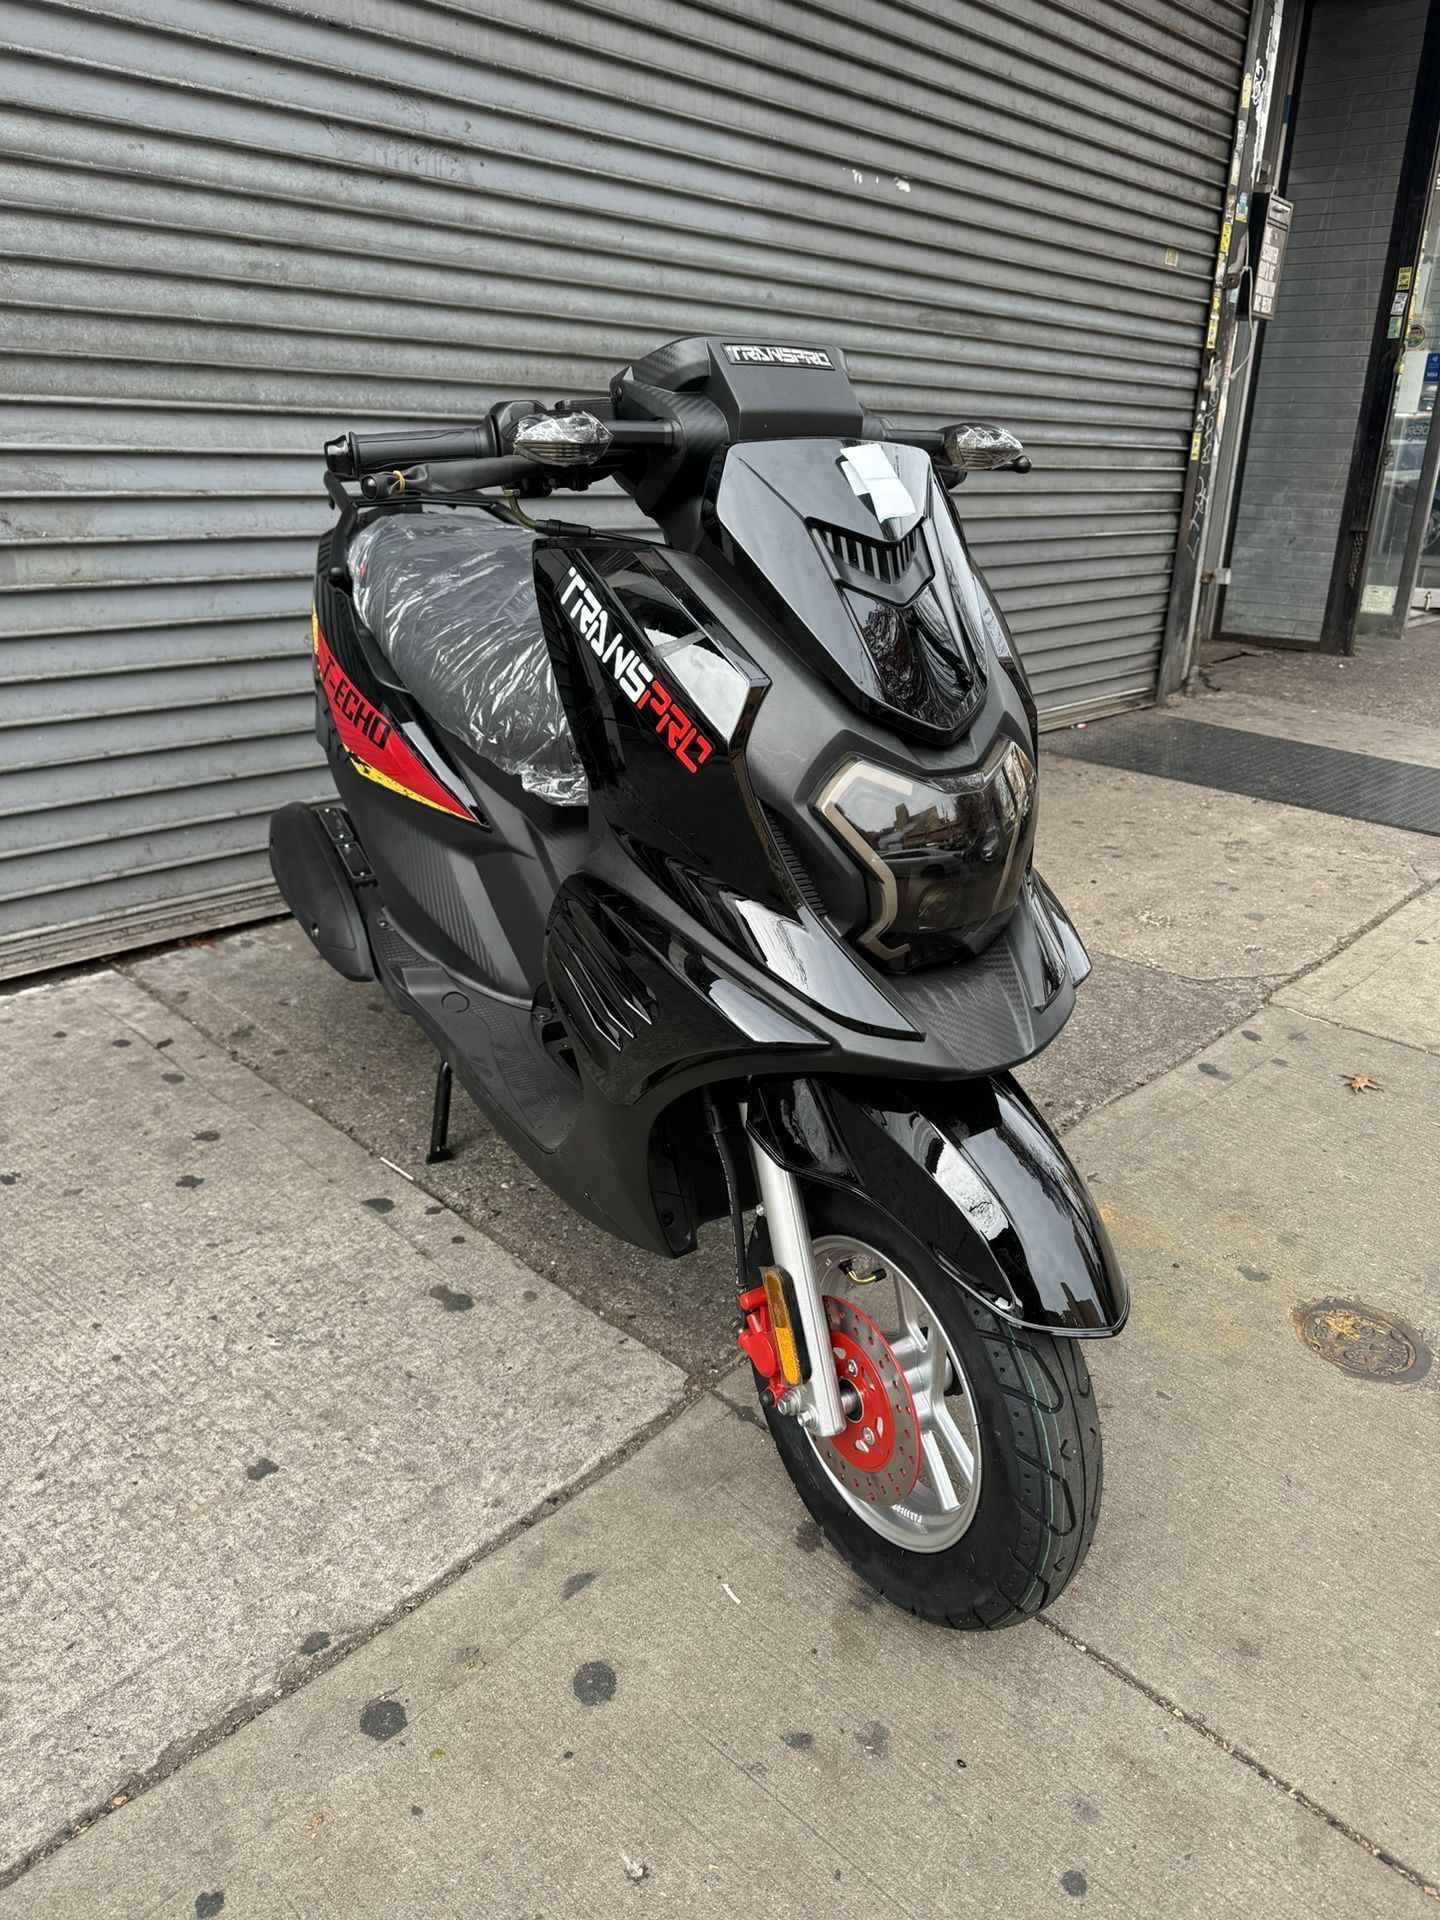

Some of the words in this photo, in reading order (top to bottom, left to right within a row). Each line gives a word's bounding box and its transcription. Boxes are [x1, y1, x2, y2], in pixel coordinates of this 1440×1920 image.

[724, 345, 833, 368] TRANSPRO
[321, 656, 392, 750] T-ECHO
[560, 566, 713, 774] TRANSPRO
